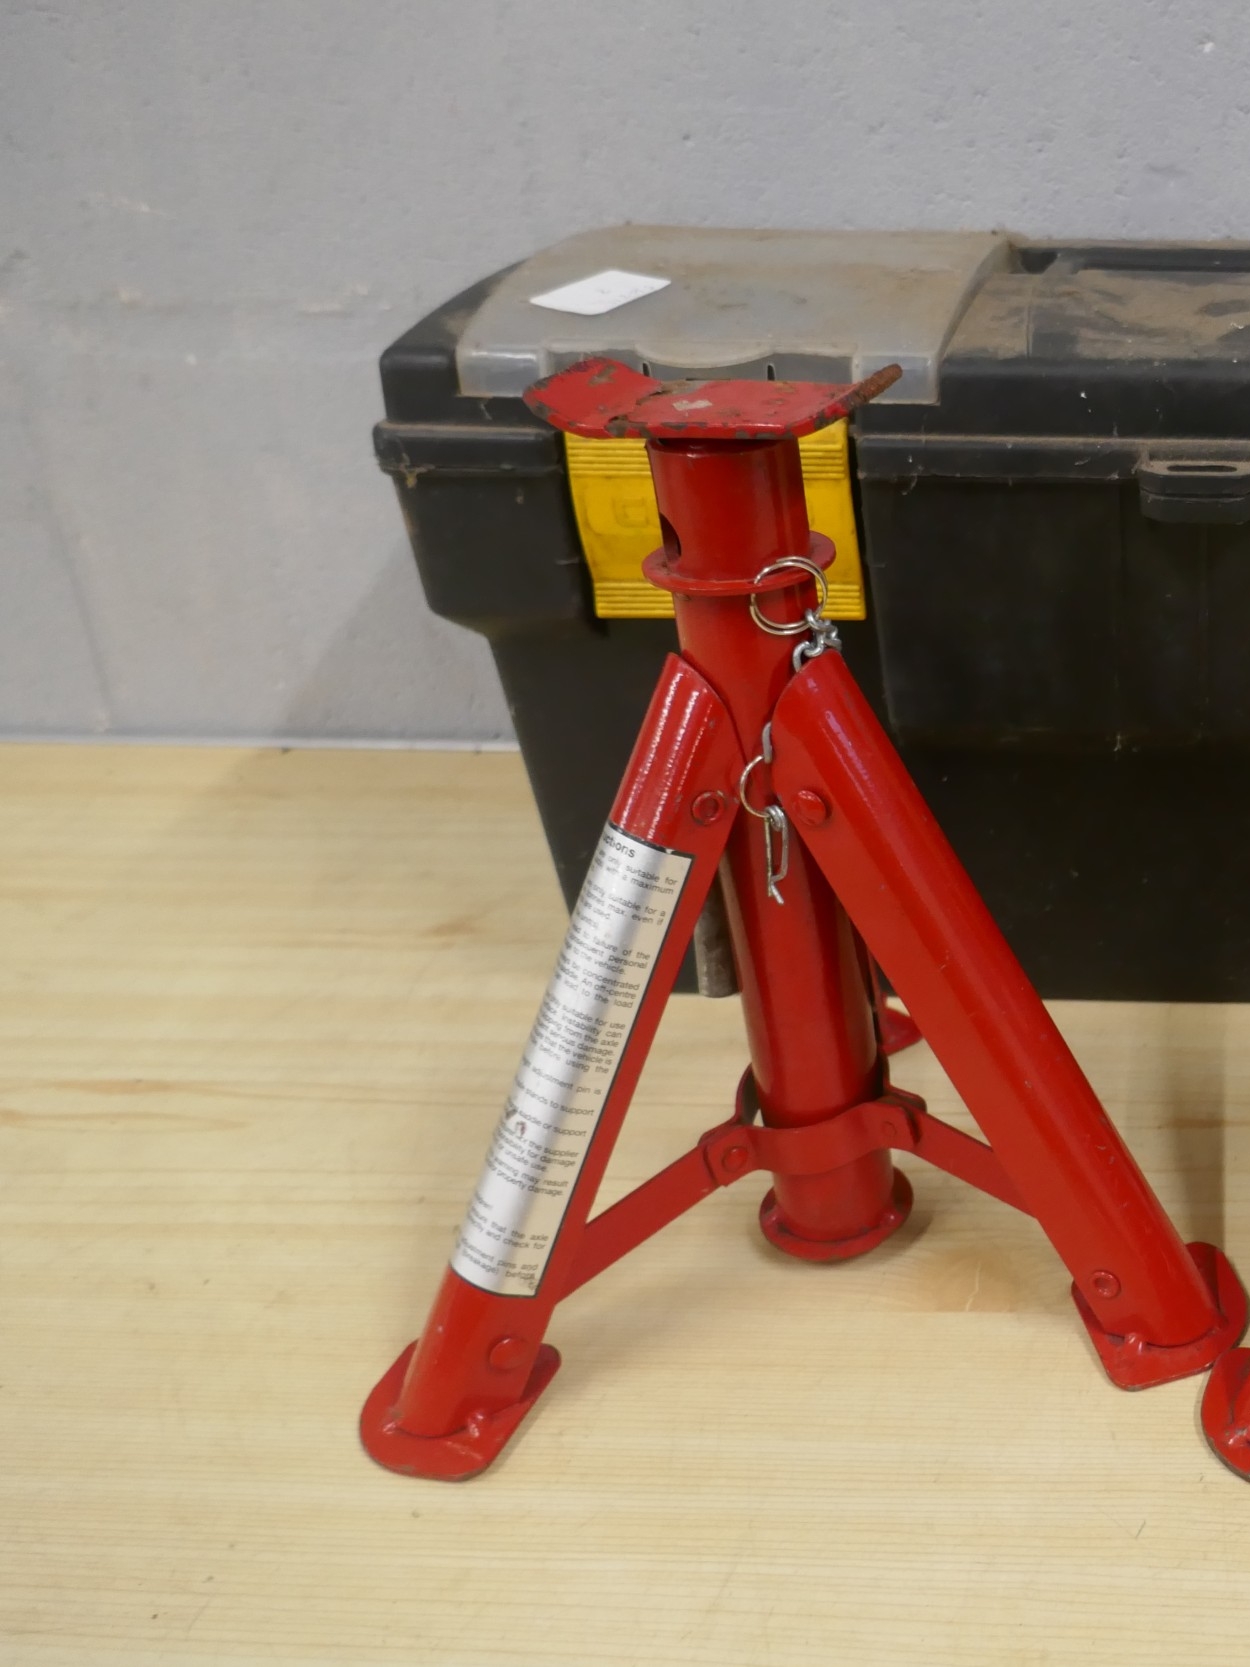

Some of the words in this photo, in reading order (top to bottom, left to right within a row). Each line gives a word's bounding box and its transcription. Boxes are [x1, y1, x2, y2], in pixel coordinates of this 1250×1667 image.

[665, 877, 678, 885] for
[631, 878, 674, 895] maximum
[645, 906, 658, 914] for
[632, 914, 653, 924] even
[608, 954, 648, 969] personal
[614, 1000, 633, 1008] load
[560, 1106, 594, 1115] support
[553, 1127, 587, 1137] support
[544, 1148, 579, 1157] supplier
[540, 1156, 575, 1167] damage
